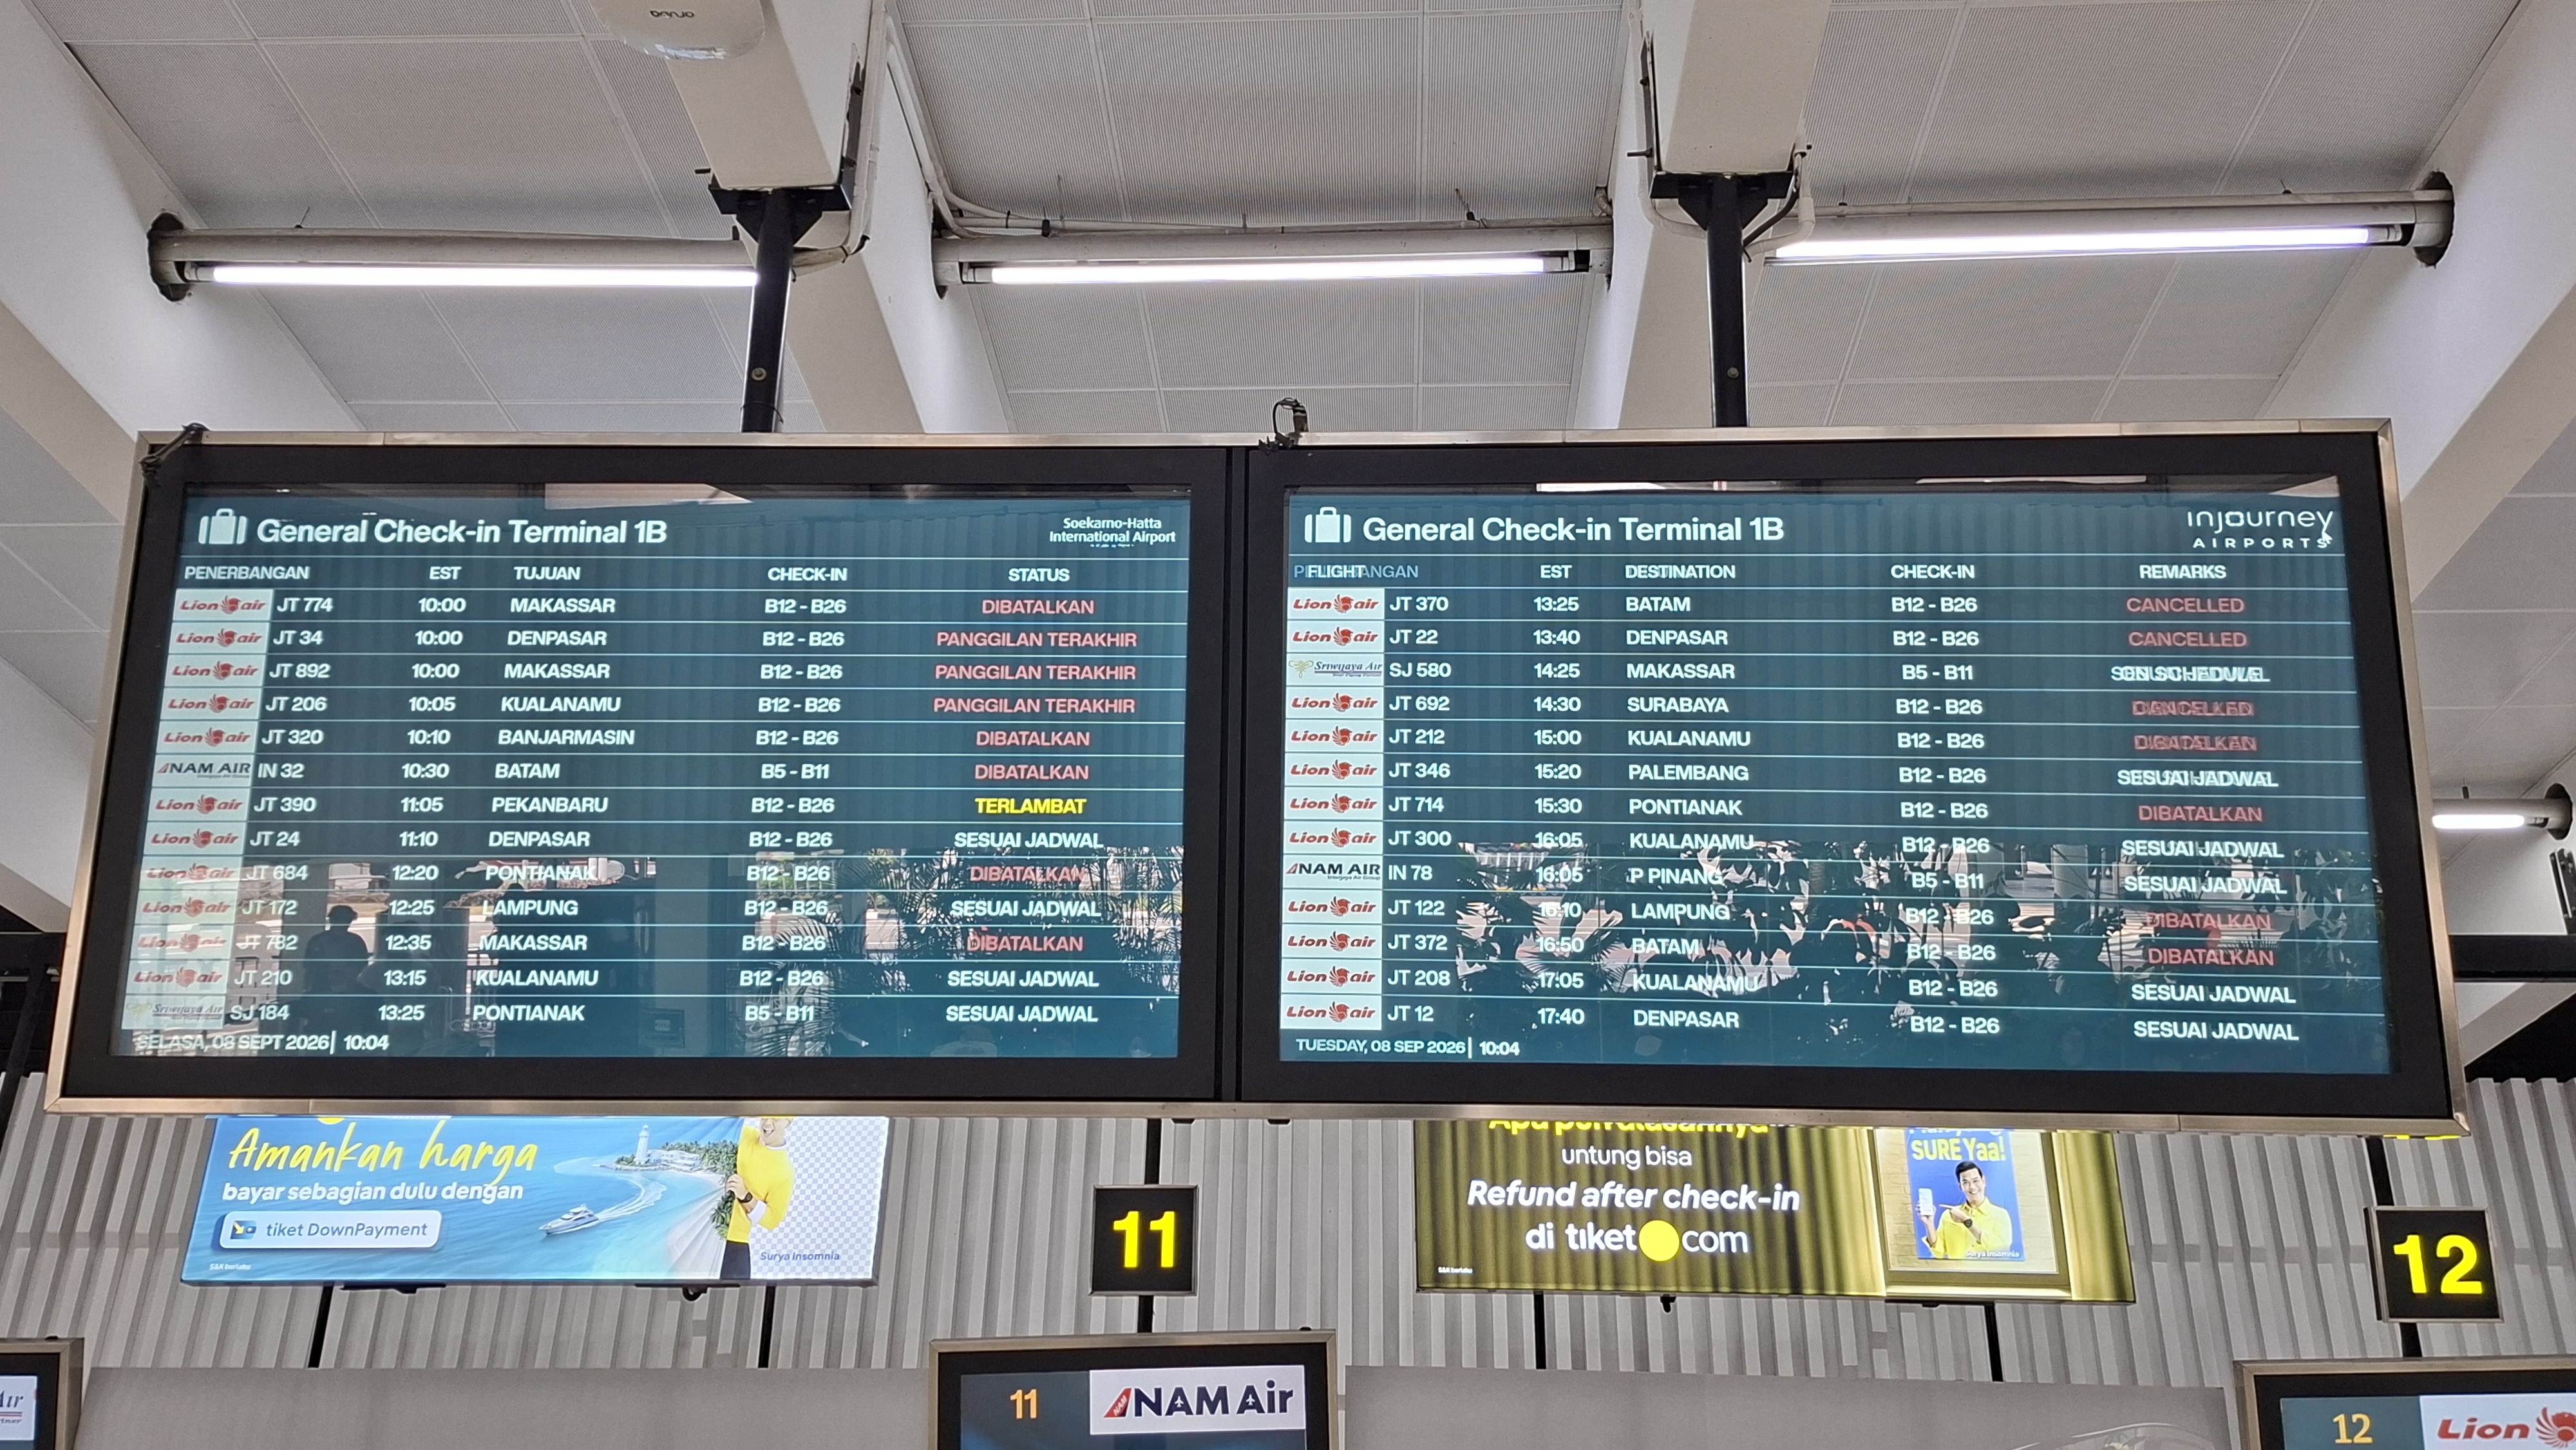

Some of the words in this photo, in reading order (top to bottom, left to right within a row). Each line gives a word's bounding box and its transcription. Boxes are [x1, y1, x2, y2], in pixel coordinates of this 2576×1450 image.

[1063, 517, 1162, 529] Soekarno-Hatta
[1363, 518, 1473, 541] General
[1482, 518, 1611, 541] Check-in
[1619, 517, 1741, 541] Terminal
[1750, 518, 1784, 540] 1B
[258, 519, 368, 542] General
[375, 519, 500, 542] Check-in
[509, 520, 627, 543] Terminal
[634, 521, 667, 543] 1B
[1050, 531, 1130, 542] International
[1133, 531, 1176, 545] Airport
[2193, 538, 2327, 549] AIRPORTS
[185, 566, 310, 579] PENERBANGAN
[430, 567, 462, 579] EST
[514, 567, 580, 579] TUJUAN
[768, 567, 848, 581] CHECK-IN
[1009, 569, 1070, 581] STATUS
[1541, 565, 1572, 578] EST
[1625, 565, 1736, 578] DESTINATION
[1891, 565, 1975, 578] CHECK-IN
[2140, 565, 2226, 578] REMARKS
[180, 599, 219, 612] Lion
[241, 599, 265, 612] air
[277, 598, 301, 612] JT
[303, 598, 333, 612] 774
[419, 598, 466, 612] 10:00
[511, 598, 616, 612] MAKASSAR
[765, 599, 796, 613] B12
[811, 599, 846, 613] B26
[983, 600, 1094, 614] DIBATALKAN
[1390, 597, 1412, 611] JT
[1416, 597, 1448, 611] 370
[1534, 597, 1579, 611] 13:25
[1626, 597, 1690, 611] BATAM
[1892, 598, 1924, 612] B12
[1941, 598, 1978, 612] B26
[2126, 598, 2244, 612] CANCELLED
[507, 631, 607, 645] DENPASAR
[937, 632, 1042, 646] PANGGILAN
[1047, 632, 1137, 646] TERAKHIR
[1627, 630, 1728, 645] DENPASAR
[2128, 632, 2247, 647] CANCELLED
[412, 664, 460, 678] 10:00
[504, 664, 610, 678] MAKASSAR
[936, 665, 1041, 679] PANGGILAN
[1046, 666, 1136, 680] TERAKHIR
[1390, 663, 1412, 677] SJ
[1417, 663, 1451, 677] 580
[1534, 663, 1580, 678] 14:25
[1627, 664, 1735, 679] MAKASSAR
[502, 697, 621, 711] KUALANAMU
[934, 698, 1040, 713] PANGGILAN
[1045, 699, 1135, 713] TERAKHIR
[1627, 697, 1729, 712] SURABAYA
[408, 730, 451, 744] 10:10
[498, 730, 635, 744] BANJARMASIN
[977, 731, 1090, 746] DIBATALKAN
[1534, 730, 1582, 744] 15:00
[1628, 731, 1750, 746] KUALANAMU
[258, 763, 278, 778] IN
[280, 763, 304, 778] 32
[495, 764, 560, 778] BATAM
[975, 765, 1088, 780] DIBATALKAN
[1629, 765, 1748, 780] PALEMBANG
[401, 797, 443, 812] 11:05
[492, 797, 608, 812] PEKANBARU
[975, 798, 1086, 814] TERLAMBAT
[1535, 798, 1582, 813] 15:30
[1630, 799, 1743, 815] PONTIANAK
[2139, 805, 2262, 822] DIBATALKAN
[489, 831, 590, 846] DENPASAR
[954, 833, 1021, 851] SESUAI
[1025, 833, 1104, 849] JADWAL
[1630, 834, 1753, 849] KUALANAMU
[392, 865, 439, 880] 12:20
[486, 866, 596, 880] PONTIANAK
[970, 867, 1084, 881] DIBATALKAN
[1347, 863, 1381, 874] AIR
[1389, 865, 1406, 880] IN
[1411, 865, 1432, 880] 78
[1646, 869, 1722, 884] PINANG
[482, 901, 578, 916] LAMPUNG
[1631, 904, 1729, 919] LAMPUNG
[386, 936, 431, 950] 12:35
[480, 936, 587, 950] MAKASSAR
[967, 936, 1083, 951] DIBATALKAN
[1632, 939, 1699, 954] BATAM
[2148, 948, 2275, 965] DIBATALKAN
[476, 971, 598, 986] KUALANAMU
[1539, 972, 1584, 988] 17:05
[1633, 974, 1758, 991] KUALANAMU
[2132, 984, 2204, 1001] SESUAI
[2209, 986, 2296, 1003] JADWAL
[231, 1005, 255, 1020] SJ
[259, 1005, 289, 1020] 184
[379, 1005, 425, 1021] 13:25
[473, 1005, 584, 1021] PONTIANAK
[946, 1006, 1014, 1021] SESUAI
[1018, 1006, 1098, 1022] JADWAL
[1287, 1006, 1325, 1018] Lion
[1351, 1007, 1374, 1018] air
[1538, 1008, 1584, 1024] 17:40
[1634, 1010, 1739, 1028] DENPASAR
[2134, 1021, 2207, 1039] SESUAI
[2211, 1022, 2299, 1040] JADWAL
[238, 1035, 285, 1050] SEPT
[345, 1036, 389, 1050] 10:04
[1296, 1039, 1367, 1054] TUESDAY,
[1371, 1040, 1390, 1052] 08
[1394, 1040, 1424, 1053] SEP
[1479, 1041, 1520, 1055] 10:04
[229, 1122, 403, 1171] Amankan
[419, 1120, 537, 1187] harga
[1911, 1140, 1962, 1160] SURE
[1962, 1136, 2006, 1161] Yaa!
[1561, 1145, 1641, 1171] untung
[1645, 1145, 1692, 1166] bisa
[222, 1183, 285, 1204] bayar
[287, 1182, 385, 1205] sebagian
[390, 1182, 437, 1200] dulu
[441, 1183, 524, 1205] dengan
[1467, 1180, 1577, 1207] Refund
[1581, 1181, 1658, 1208] after
[1663, 1183, 1800, 1210] check-in
[266, 1223, 303, 1236] tiket
[307, 1223, 428, 1240] DownPayment
[1525, 1223, 1554, 1249] di
[1113, 1211, 1175, 1268] 11
[761, 1252, 790, 1262] Surya
[792, 1251, 840, 1261] Insomnia
[2393, 1235, 2483, 1294] 12
[1010, 1389, 1037, 1419] 11
[1134, 1386, 1229, 1417] NAM
[1236, 1379, 1294, 1414] Air
[2332, 1413, 2374, 1444] 12
[2437, 1417, 2530, 1440] Lion
